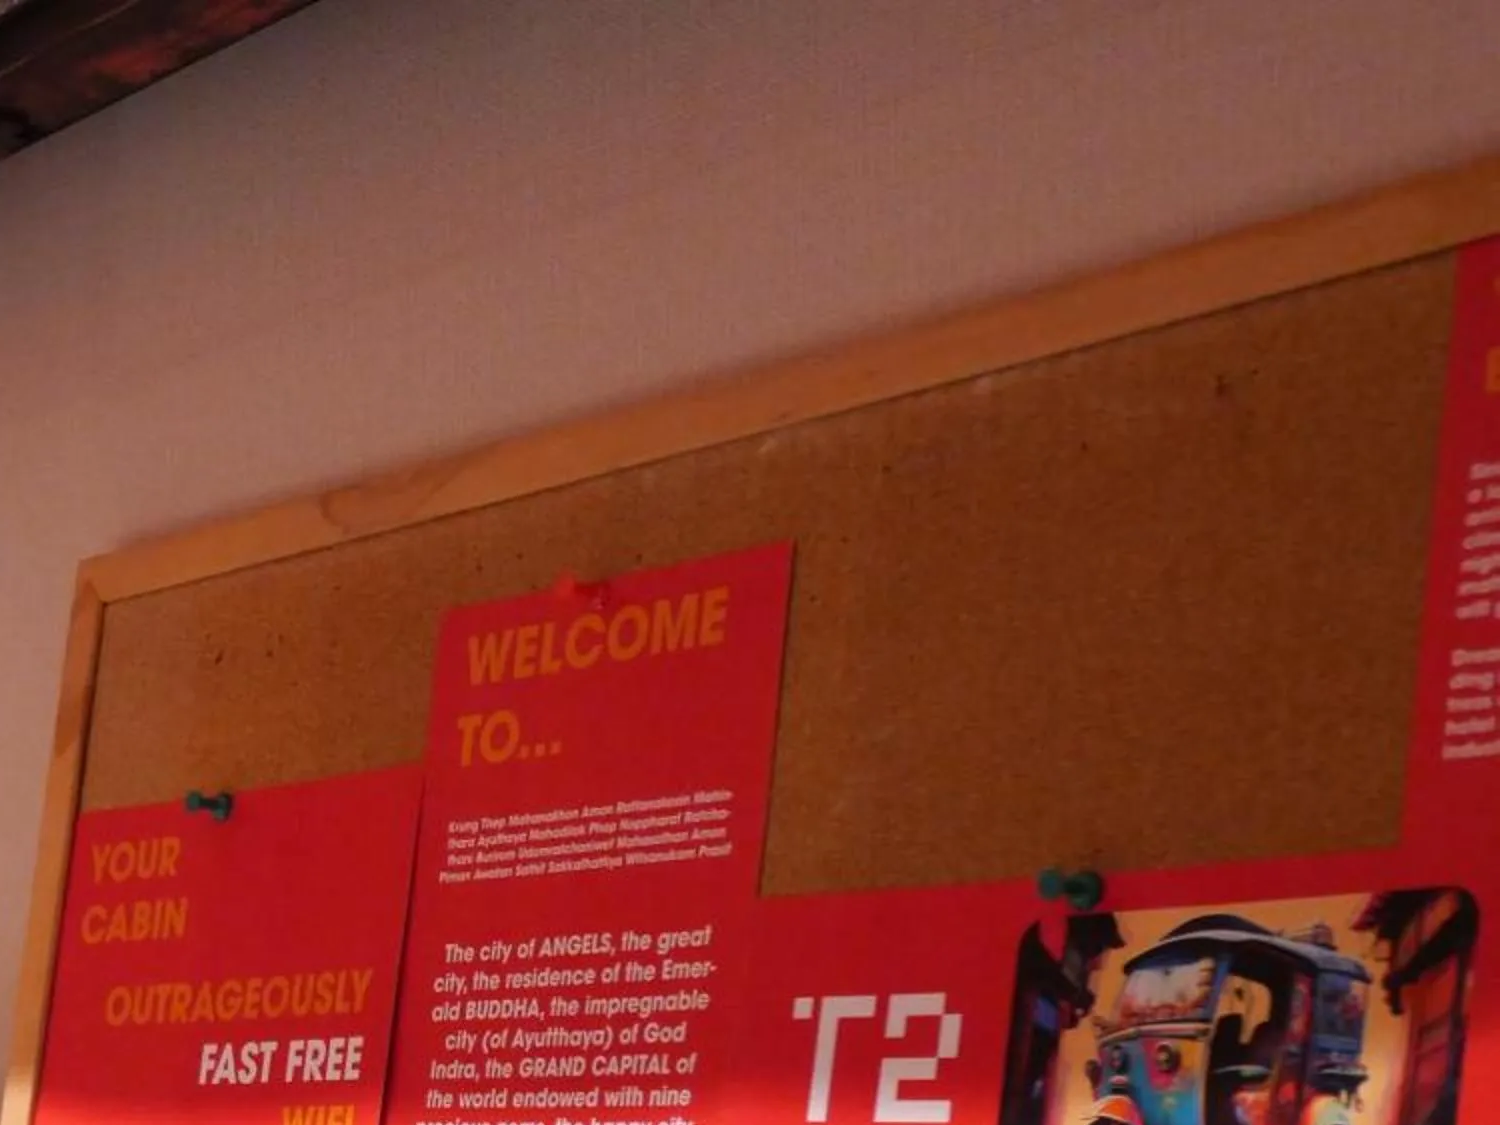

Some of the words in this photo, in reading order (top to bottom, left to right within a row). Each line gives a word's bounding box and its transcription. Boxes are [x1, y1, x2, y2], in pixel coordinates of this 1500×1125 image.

[468, 586, 730, 686] WELCOME
[457, 709, 563, 768] TO...
[91, 837, 181, 883] YOUR
[81, 897, 188, 944] CABIN
[445, 943, 475, 963] The
[479, 940, 512, 964] city
[517, 938, 536, 958] of
[538, 932, 616, 957] ANGELS,
[621, 930, 653, 951] the
[656, 925, 712, 955] great
[104, 968, 373, 1026] OUTRAGEOUSLY
[433, 972, 468, 996] city,
[472, 971, 501, 991] the
[505, 967, 596, 989] residence
[600, 962, 621, 984] of
[625, 961, 656, 982] the
[661, 958, 717, 980] Emer-
[432, 1001, 461, 1022] ald
[465, 997, 545, 1020] BUDDHA,
[550, 996, 580, 1016] the
[584, 989, 710, 1019] impregnable
[198, 1041, 278, 1085] FAST
[285, 1036, 364, 1082] FREE
[445, 1030, 478, 1054] city
[481, 1028, 509, 1054] (of
[511, 1025, 614, 1052] Ayutthaya)
[619, 1023, 640, 1045] of
[643, 1021, 687, 1043] God
[793, 992, 962, 1123] T2
[430, 1059, 480, 1082] Indra,
[485, 1057, 514, 1079] the
[518, 1056, 586, 1078] GRAND
[591, 1054, 670, 1076] CAPITAL
[676, 1052, 697, 1074] of
[426, 1089, 454, 1108] the
[459, 1088, 508, 1109] world
[512, 1087, 599, 1108] endowed
[604, 1086, 644, 1107] with
[648, 1085, 692, 1107] nine
